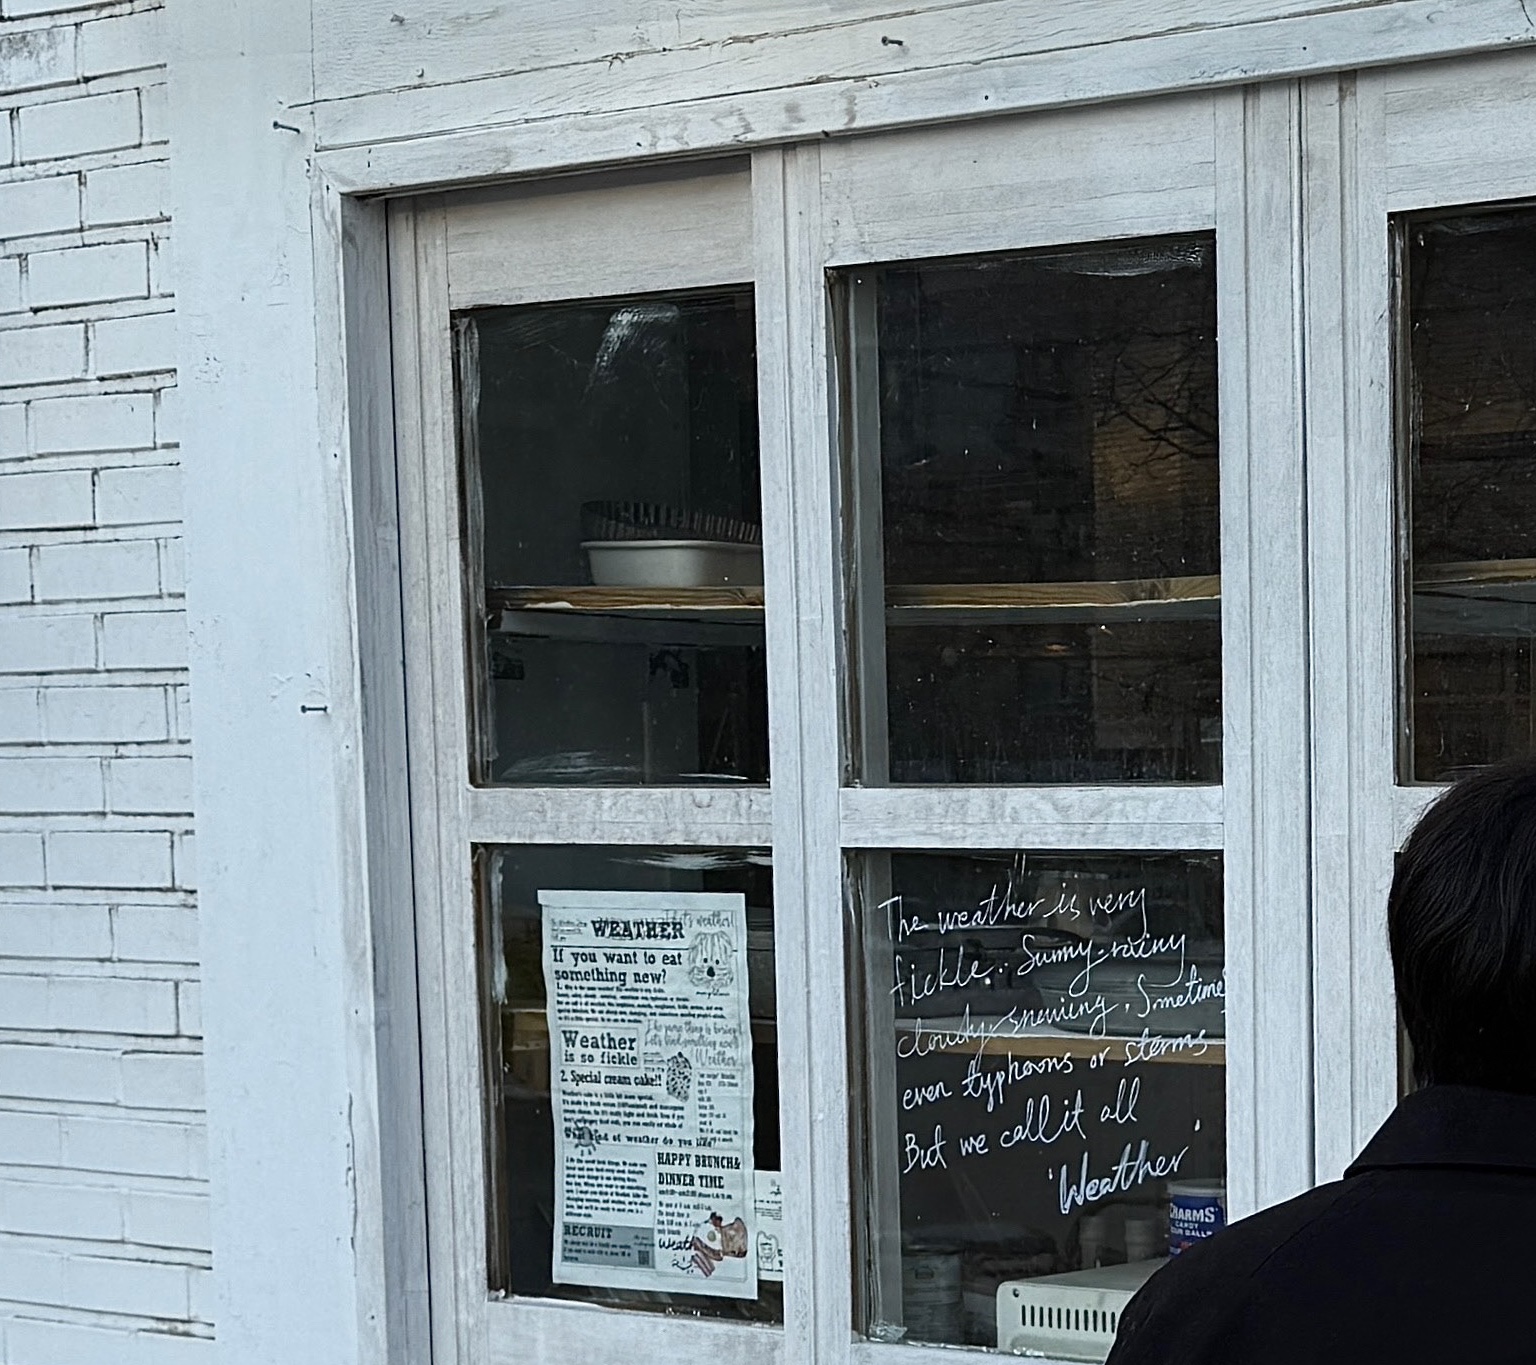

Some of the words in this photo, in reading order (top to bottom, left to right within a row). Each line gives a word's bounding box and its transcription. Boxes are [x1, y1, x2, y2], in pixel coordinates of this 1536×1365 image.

[878, 896, 926, 942] The
[938, 882, 1044, 934] weather
[1043, 882, 1081, 921] is
[1090, 888, 1147, 944] very
[592, 919, 685, 940] WEATHER
[553, 948, 564, 963] If
[571, 952, 597, 966] you
[604, 951, 637, 965] want
[644, 951, 656, 965] to
[662, 952, 682, 966] eat
[554, 968, 627, 986] something
[634, 970, 667, 984] new?
[561, 1030, 637, 1051] Weather
[564, 1051, 574, 1063] is
[581, 1052, 594, 1064] so
[600, 1051, 638, 1066] fickle
[571, 1069, 600, 1087] Special
[604, 1074, 632, 1086] cream
[903, 1083, 952, 1110] even
[962, 1051, 1074, 1111] typhoons
[1090, 1046, 1111, 1069] or
[903, 1124, 947, 1174] But
[960, 1133, 989, 1157] we
[999, 1094, 1053, 1142] call
[1059, 1090, 1087, 1140] it
[1100, 1076, 1141, 1123] all
[626, 1135, 659, 1145] weather
[678, 1139, 692, 1148] you
[657, 1152, 691, 1167] HAPPY
[695, 1154, 741, 1171] BRUNCH&
[658, 1172, 695, 1188] DINNER
[698, 1174, 725, 1189] TIME
[564, 1224, 612, 1239] RECRUIT
